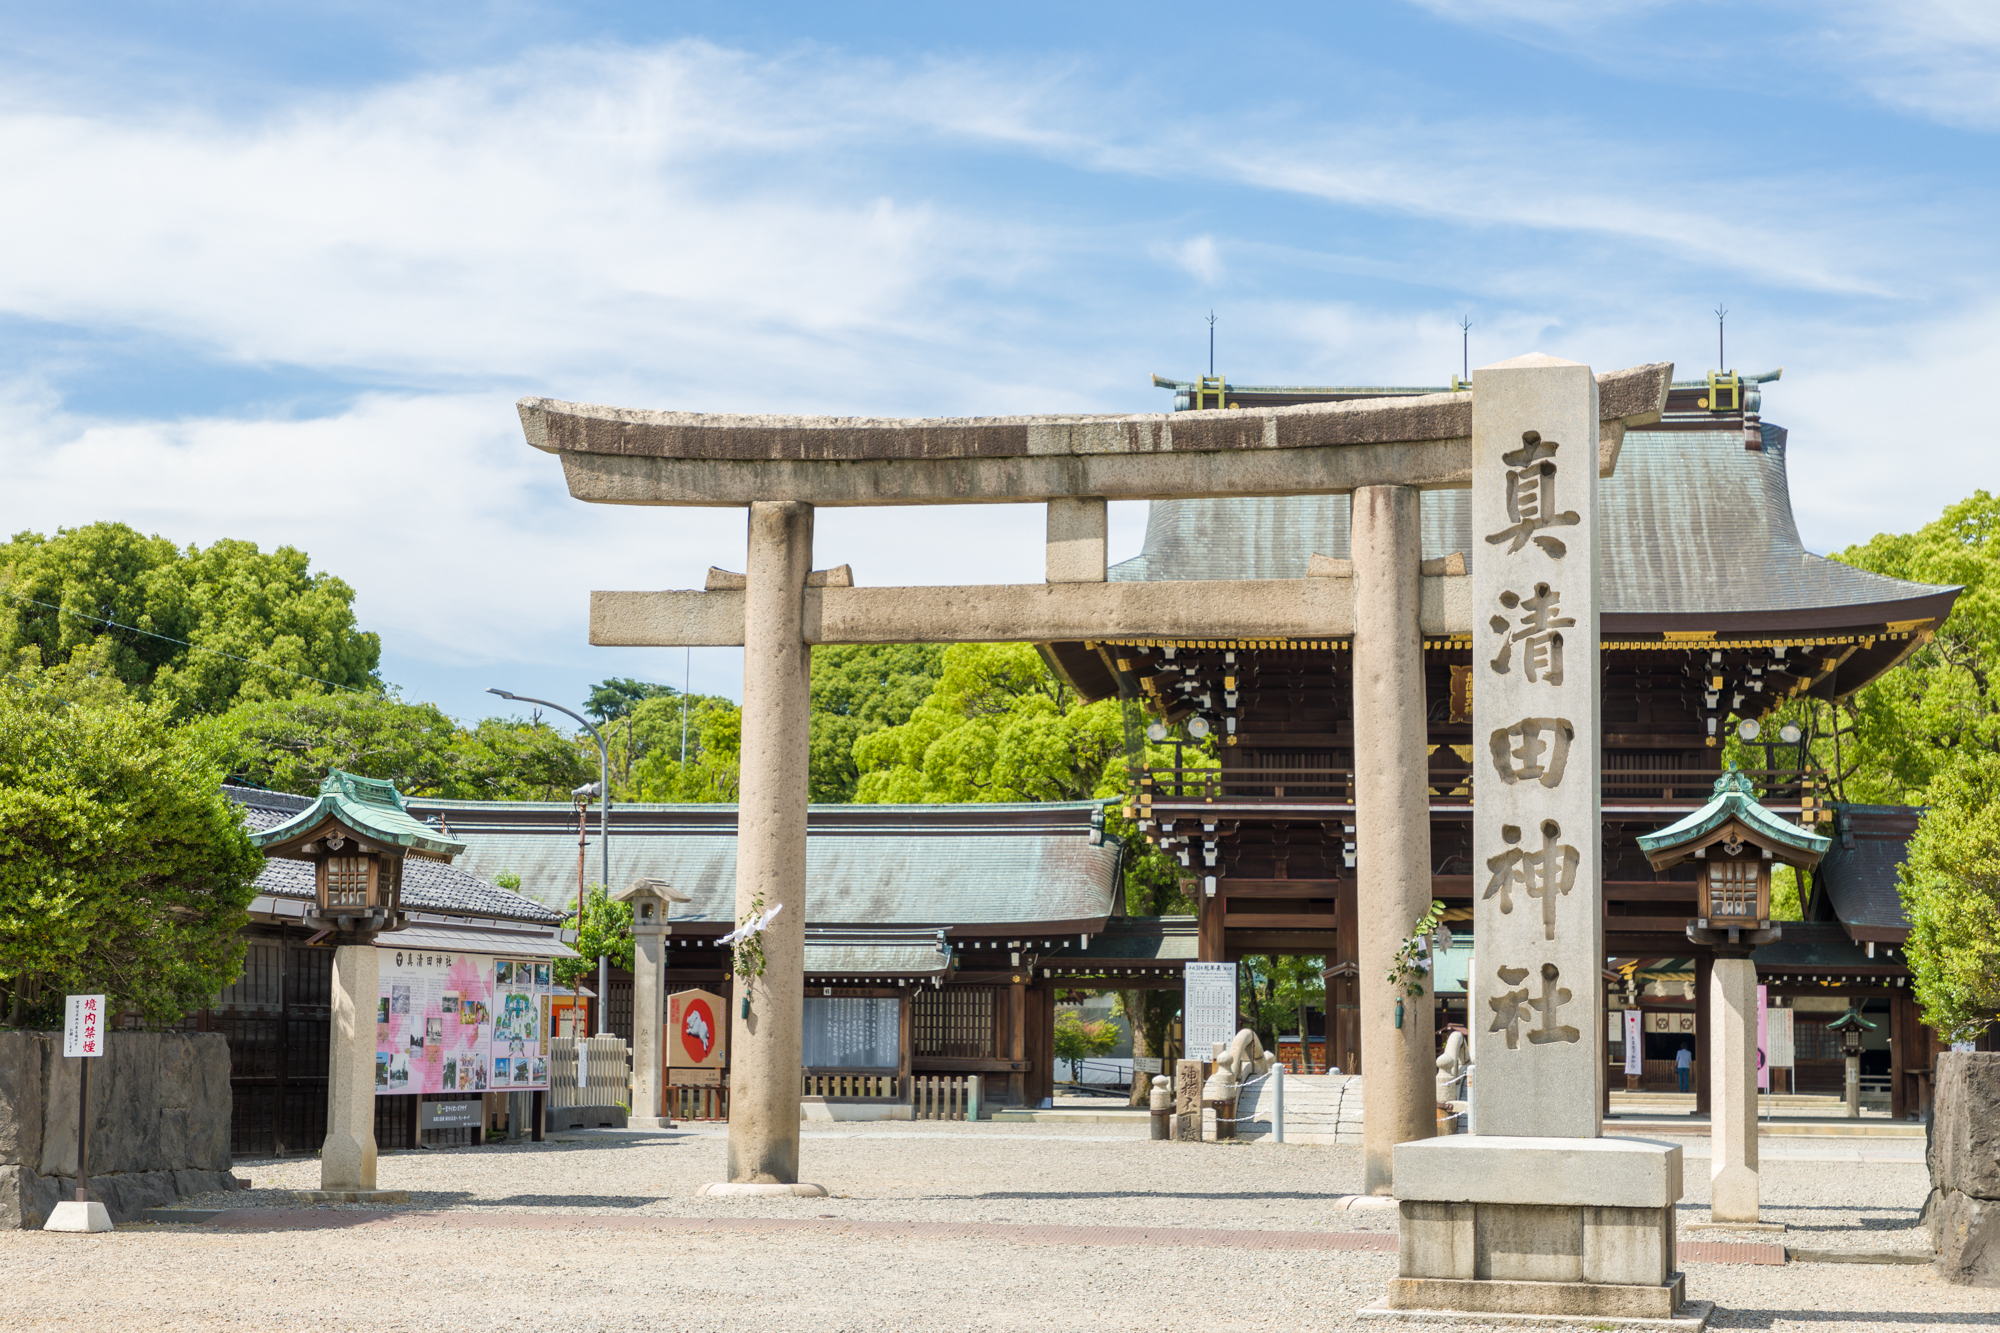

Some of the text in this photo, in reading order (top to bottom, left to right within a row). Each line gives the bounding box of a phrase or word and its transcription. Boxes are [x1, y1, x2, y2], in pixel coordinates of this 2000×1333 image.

[1482, 430, 1581, 1051] 真清田神社
[406, 952, 452, 968] 真清田神社
[83, 998, 97, 1053] 境内禁煙
